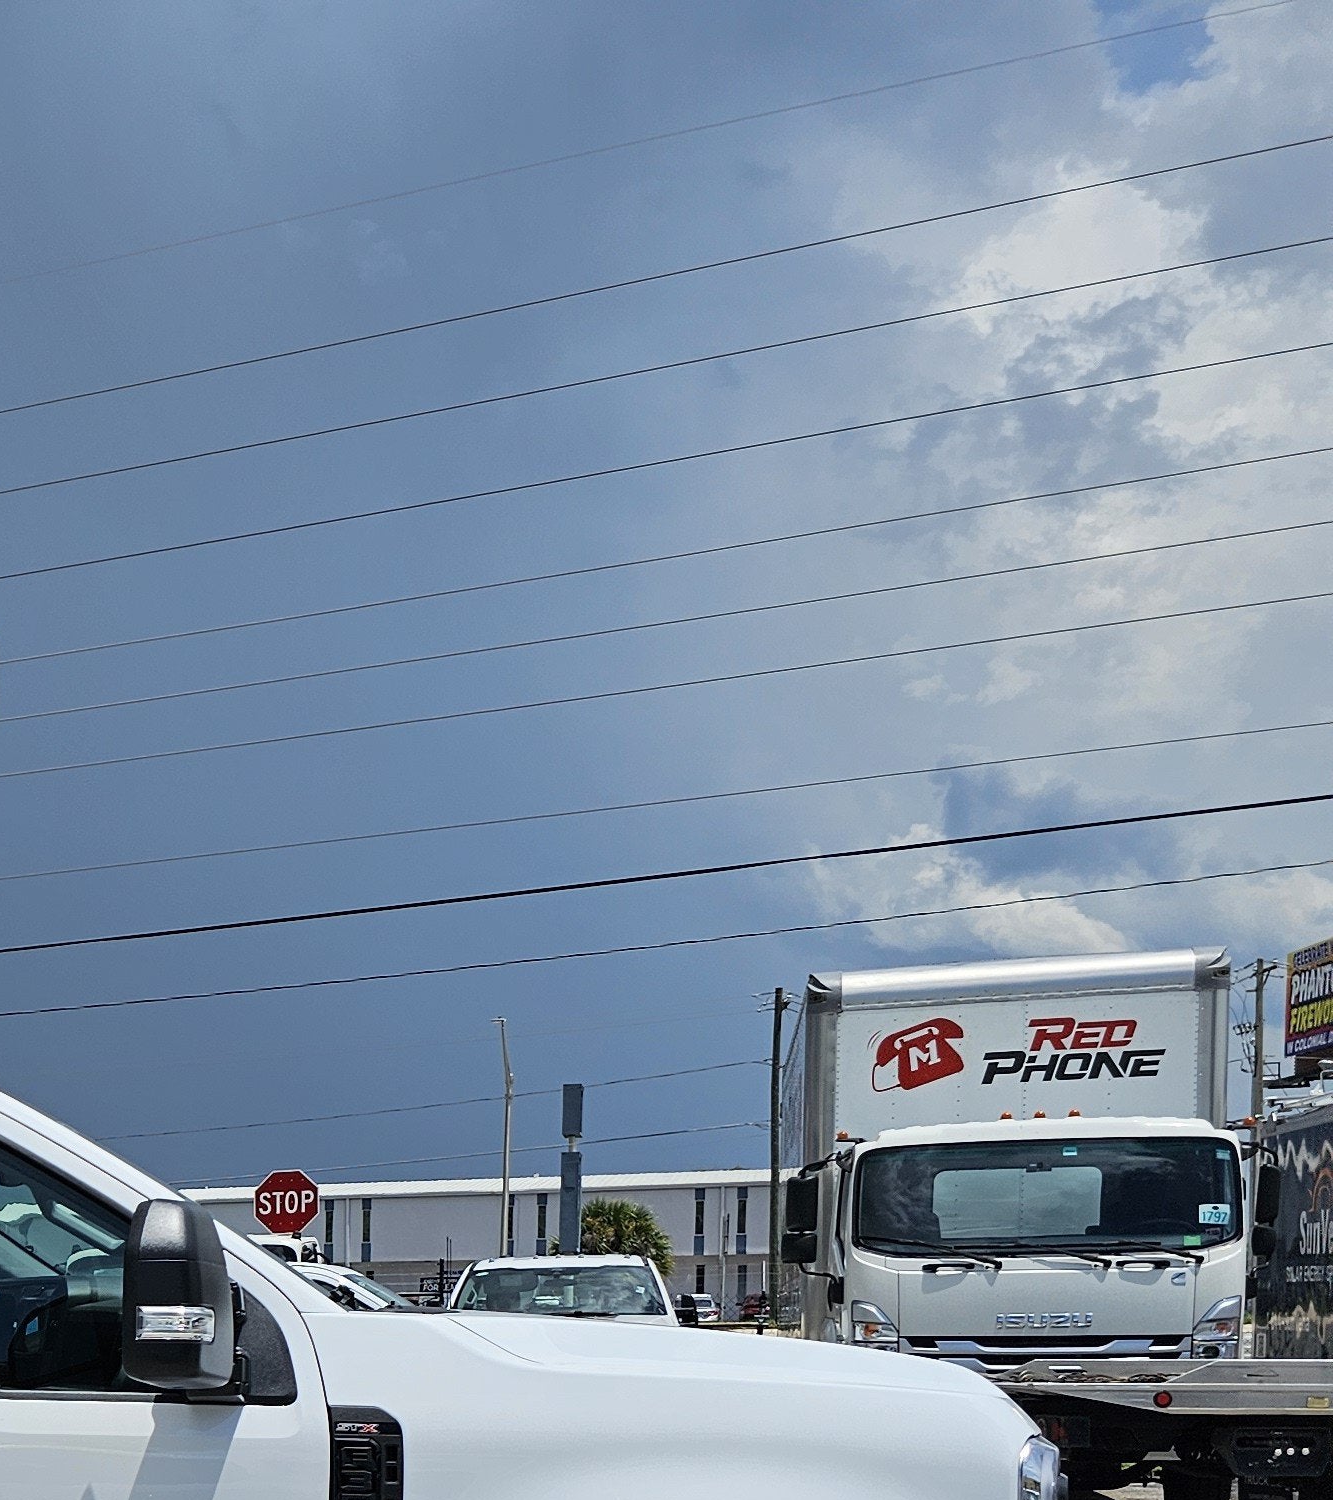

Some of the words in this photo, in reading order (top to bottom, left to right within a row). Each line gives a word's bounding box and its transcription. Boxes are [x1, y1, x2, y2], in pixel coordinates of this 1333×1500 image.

[1291, 964, 1333, 1005] PHANT
[1027, 1017, 1137, 1052] RED
[981, 1048, 1167, 1085] PHONE
[258, 1190, 315, 1215] STOP
[1202, 1211, 1228, 1223] 1797
[996, 1312, 1094, 1329] ISUZU
